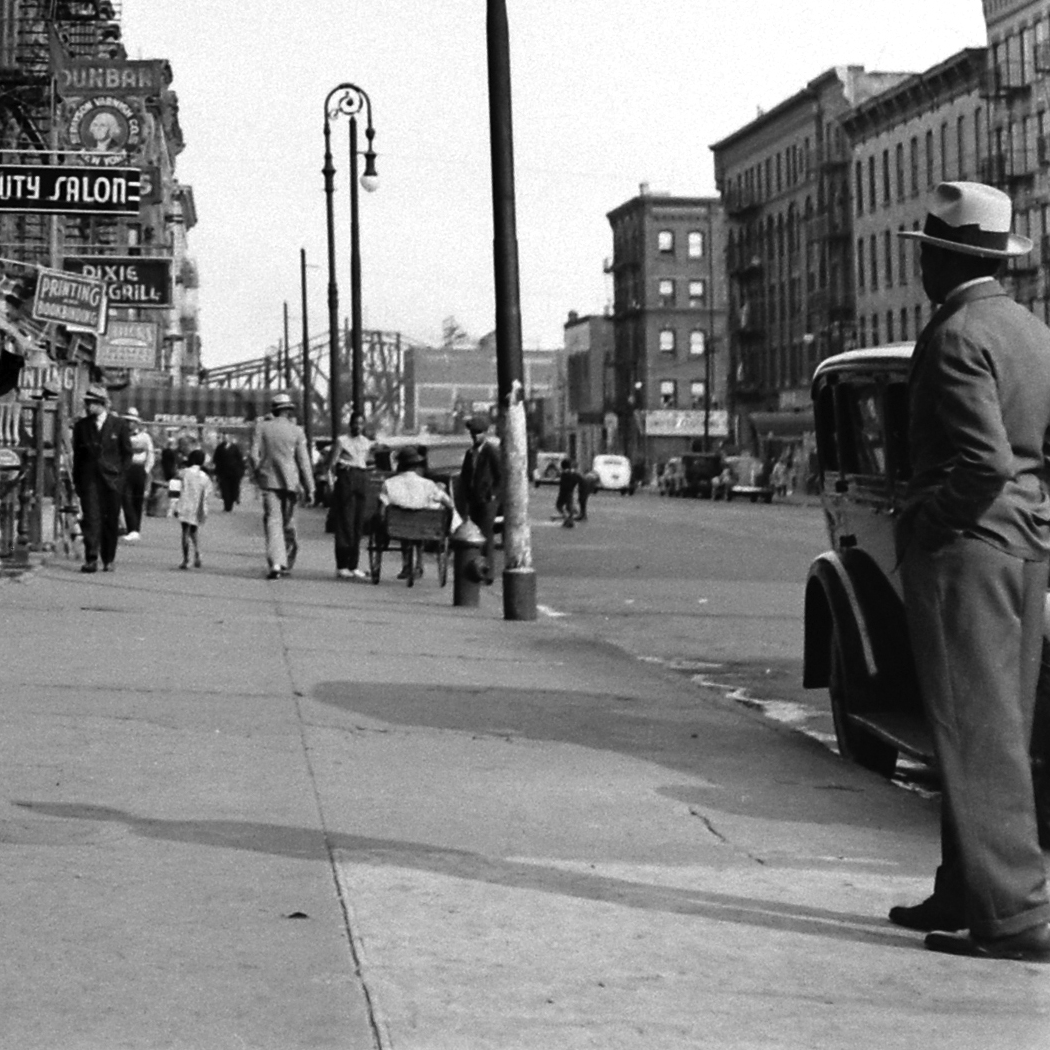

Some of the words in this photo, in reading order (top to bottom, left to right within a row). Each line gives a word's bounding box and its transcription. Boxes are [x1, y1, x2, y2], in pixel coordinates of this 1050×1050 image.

[47, 176, 126, 204] SALON
[82, 265, 138, 281] DIXIE
[41, 277, 100, 307] PRINTING
